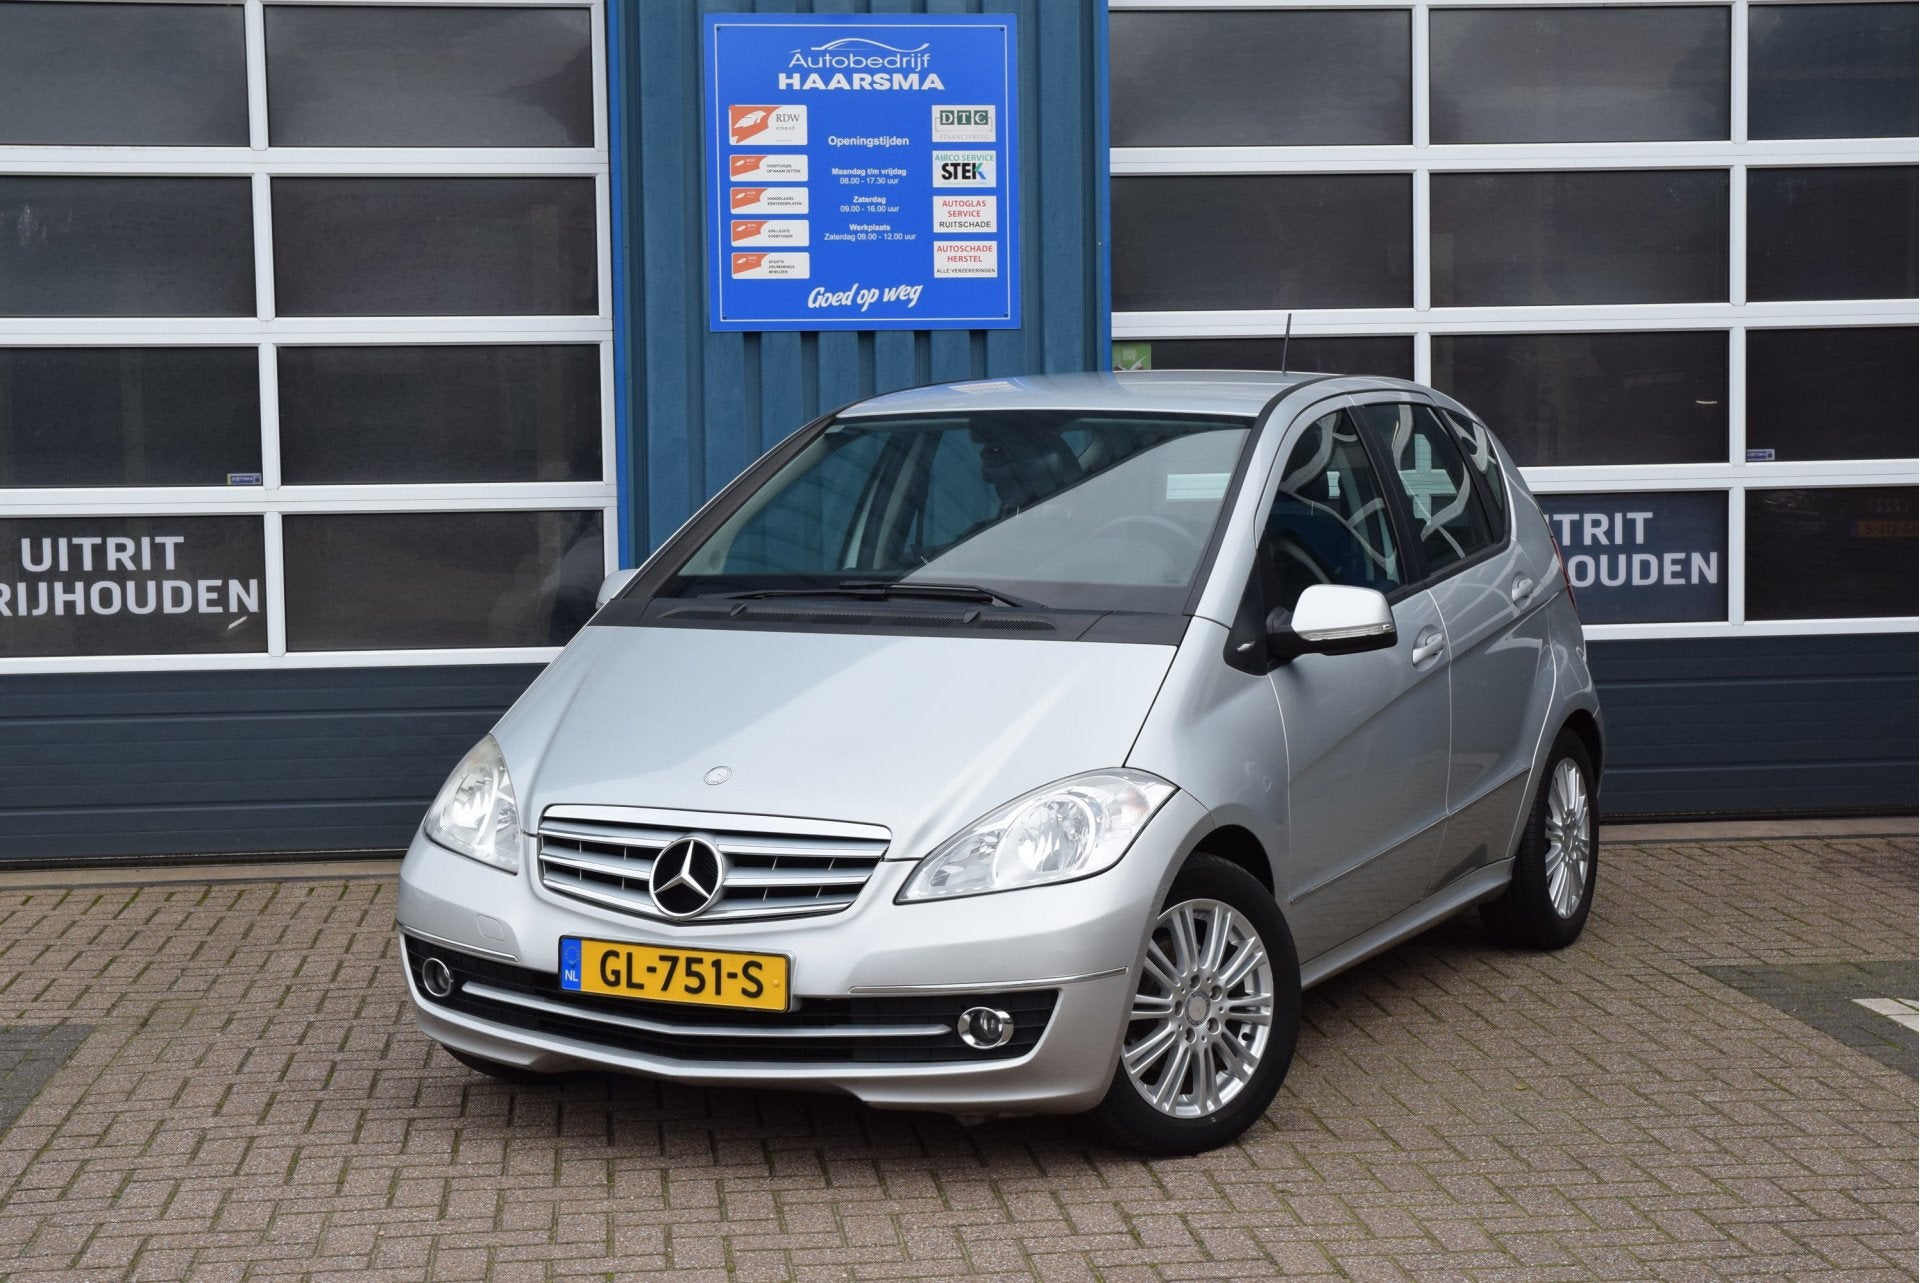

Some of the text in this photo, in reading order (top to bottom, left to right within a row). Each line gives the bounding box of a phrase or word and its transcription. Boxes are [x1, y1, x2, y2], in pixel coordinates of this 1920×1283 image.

[789, 53, 930, 72] Autobedrijf
[778, 73, 945, 90] HAARSMA
[776, 114, 800, 123] RDW
[828, 136, 909, 147] Openingstijden
[832, 168, 866, 176] Maandag
[881, 168, 906, 176] vrijdag
[941, 163, 987, 180] STEK
[853, 196, 886, 204] Zaterdag
[849, 224, 890, 232] Werkplaats
[824, 233, 855, 241] Zaterdag
[807, 283, 923, 312] Goed op weg
[21, 536, 185, 572] UITRIT
[565, 969, 579, 983] NL
[600, 949, 764, 999] GL-751-S
